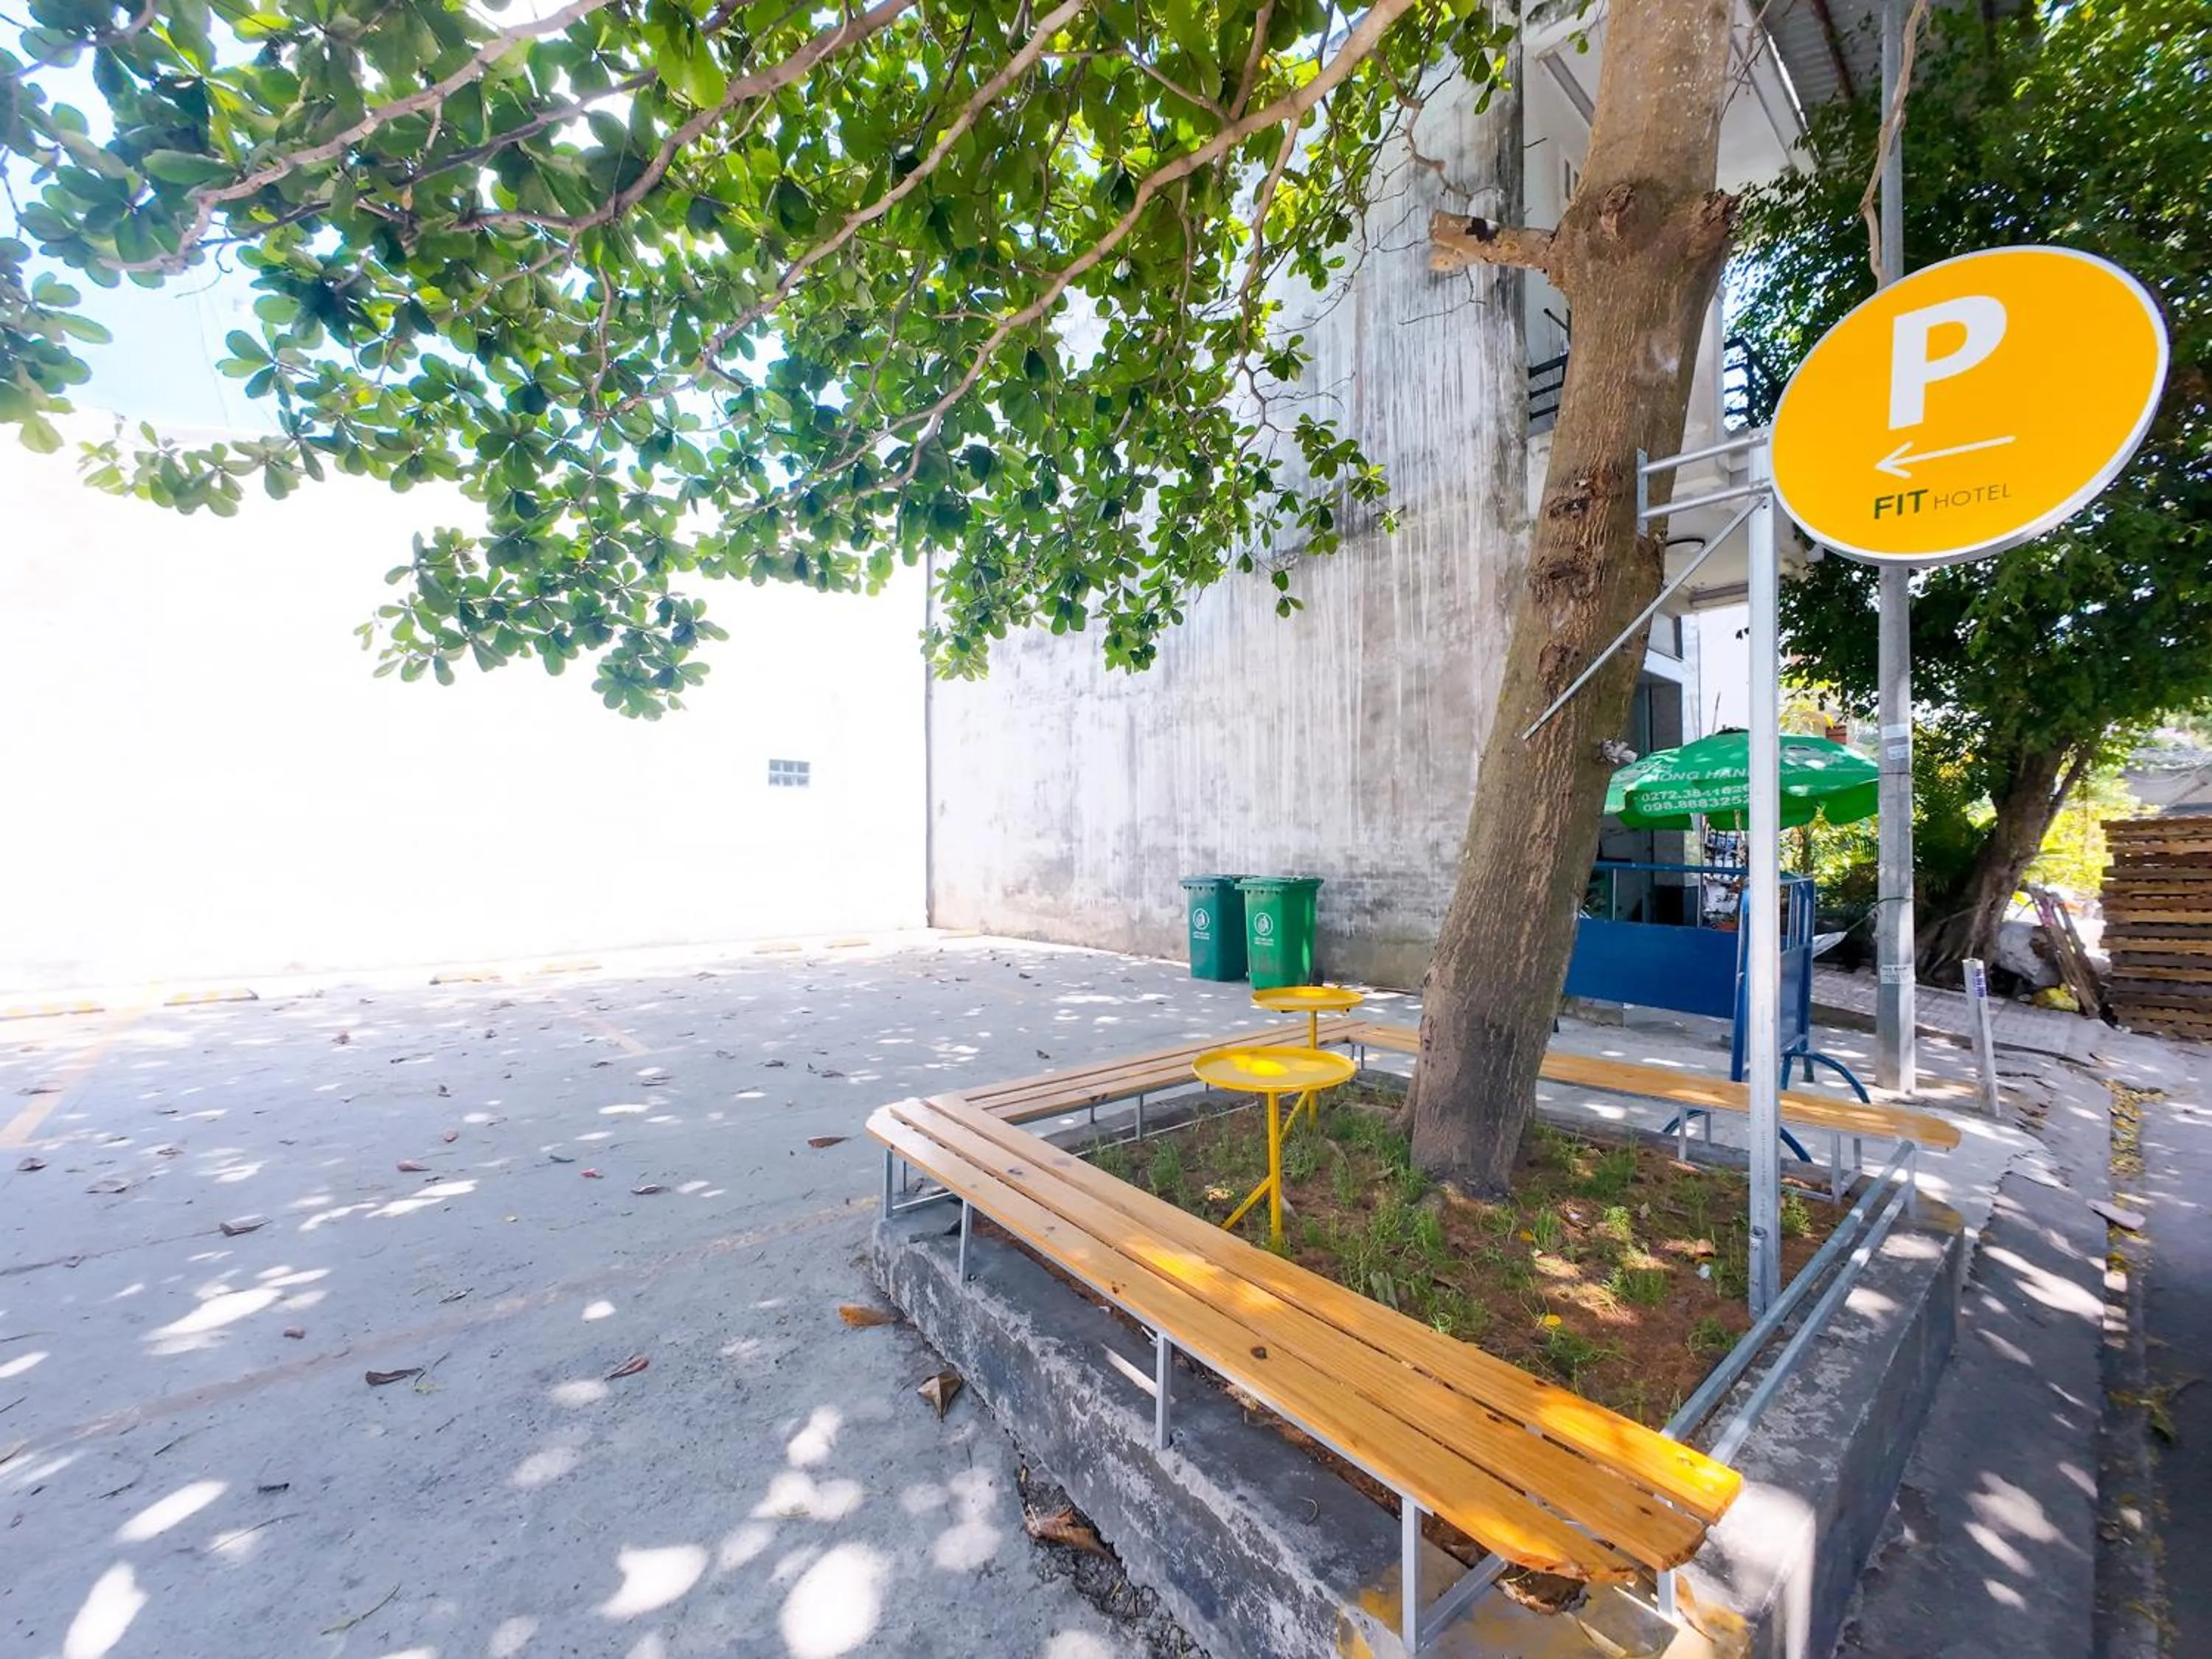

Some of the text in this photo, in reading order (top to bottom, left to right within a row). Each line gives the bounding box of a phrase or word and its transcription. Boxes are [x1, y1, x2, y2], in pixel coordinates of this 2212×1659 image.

[1888, 295, 2007, 431] P
[1874, 482, 2012, 520] FIT HOTEL
